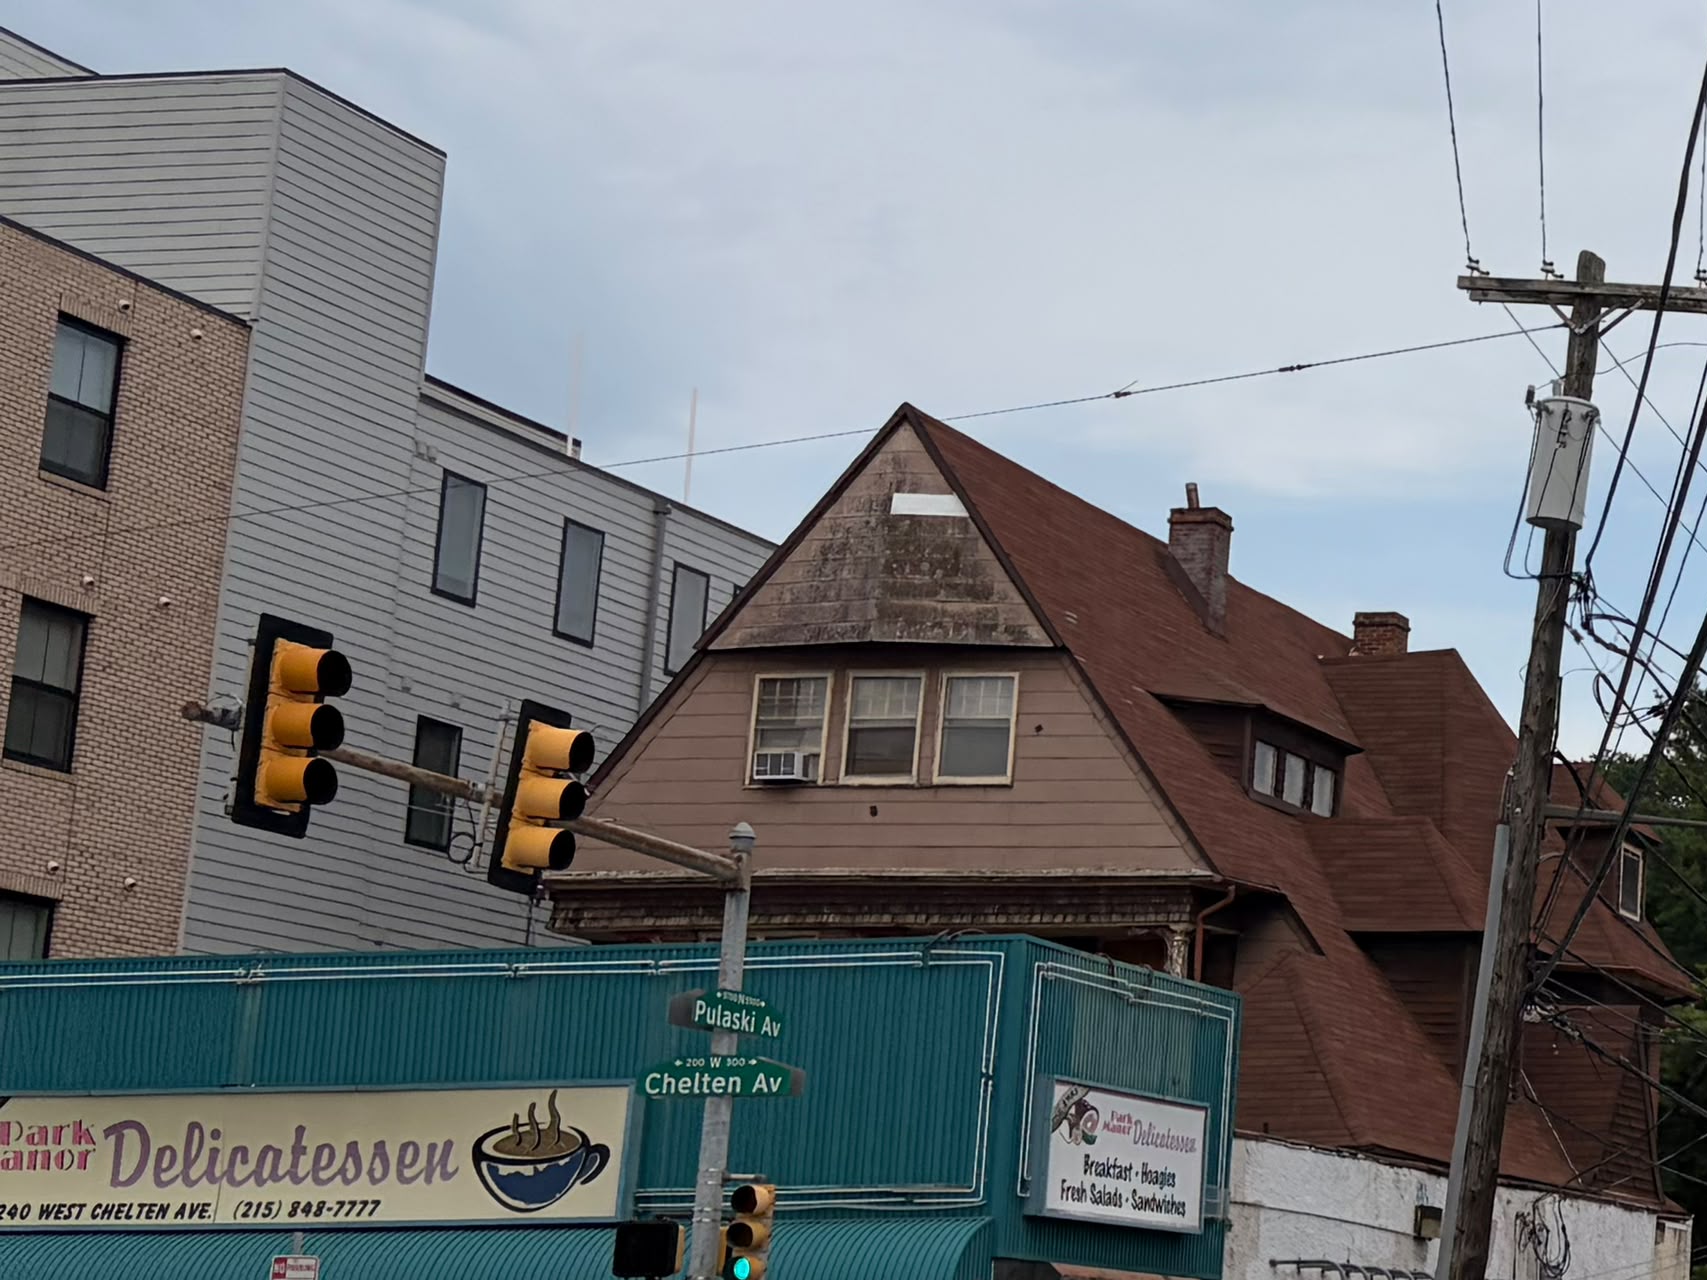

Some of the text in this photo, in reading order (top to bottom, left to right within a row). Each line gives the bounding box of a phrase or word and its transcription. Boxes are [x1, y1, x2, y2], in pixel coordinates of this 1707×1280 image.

[694, 1000, 756, 1033] Pulaski
[760, 1016, 781, 1037] Av
[686, 1058, 705, 1067] 200
[709, 1057, 722, 1068] W
[645, 1072, 782, 1095] Chelten Av
[0, 1119, 96, 1147] Park
[1102, 1122, 1133, 1136] Manor
[1111, 1110, 1197, 1154] Park Delicatessen
[0, 1148, 96, 1171] anor
[103, 1120, 460, 1188] Delicatessen
[1083, 1153, 1176, 1190] Breakfast Hoagies
[38, 1203, 87, 1220] WEST
[90, 1203, 170, 1220] CHELTEN
[173, 1202, 213, 1220] AVE.
[233, 1199, 283, 1219] (215)
[287, 1199, 382, 1219] 848-7777
[1060, 1179, 1187, 1218] Fresh Salads Sandwiches
